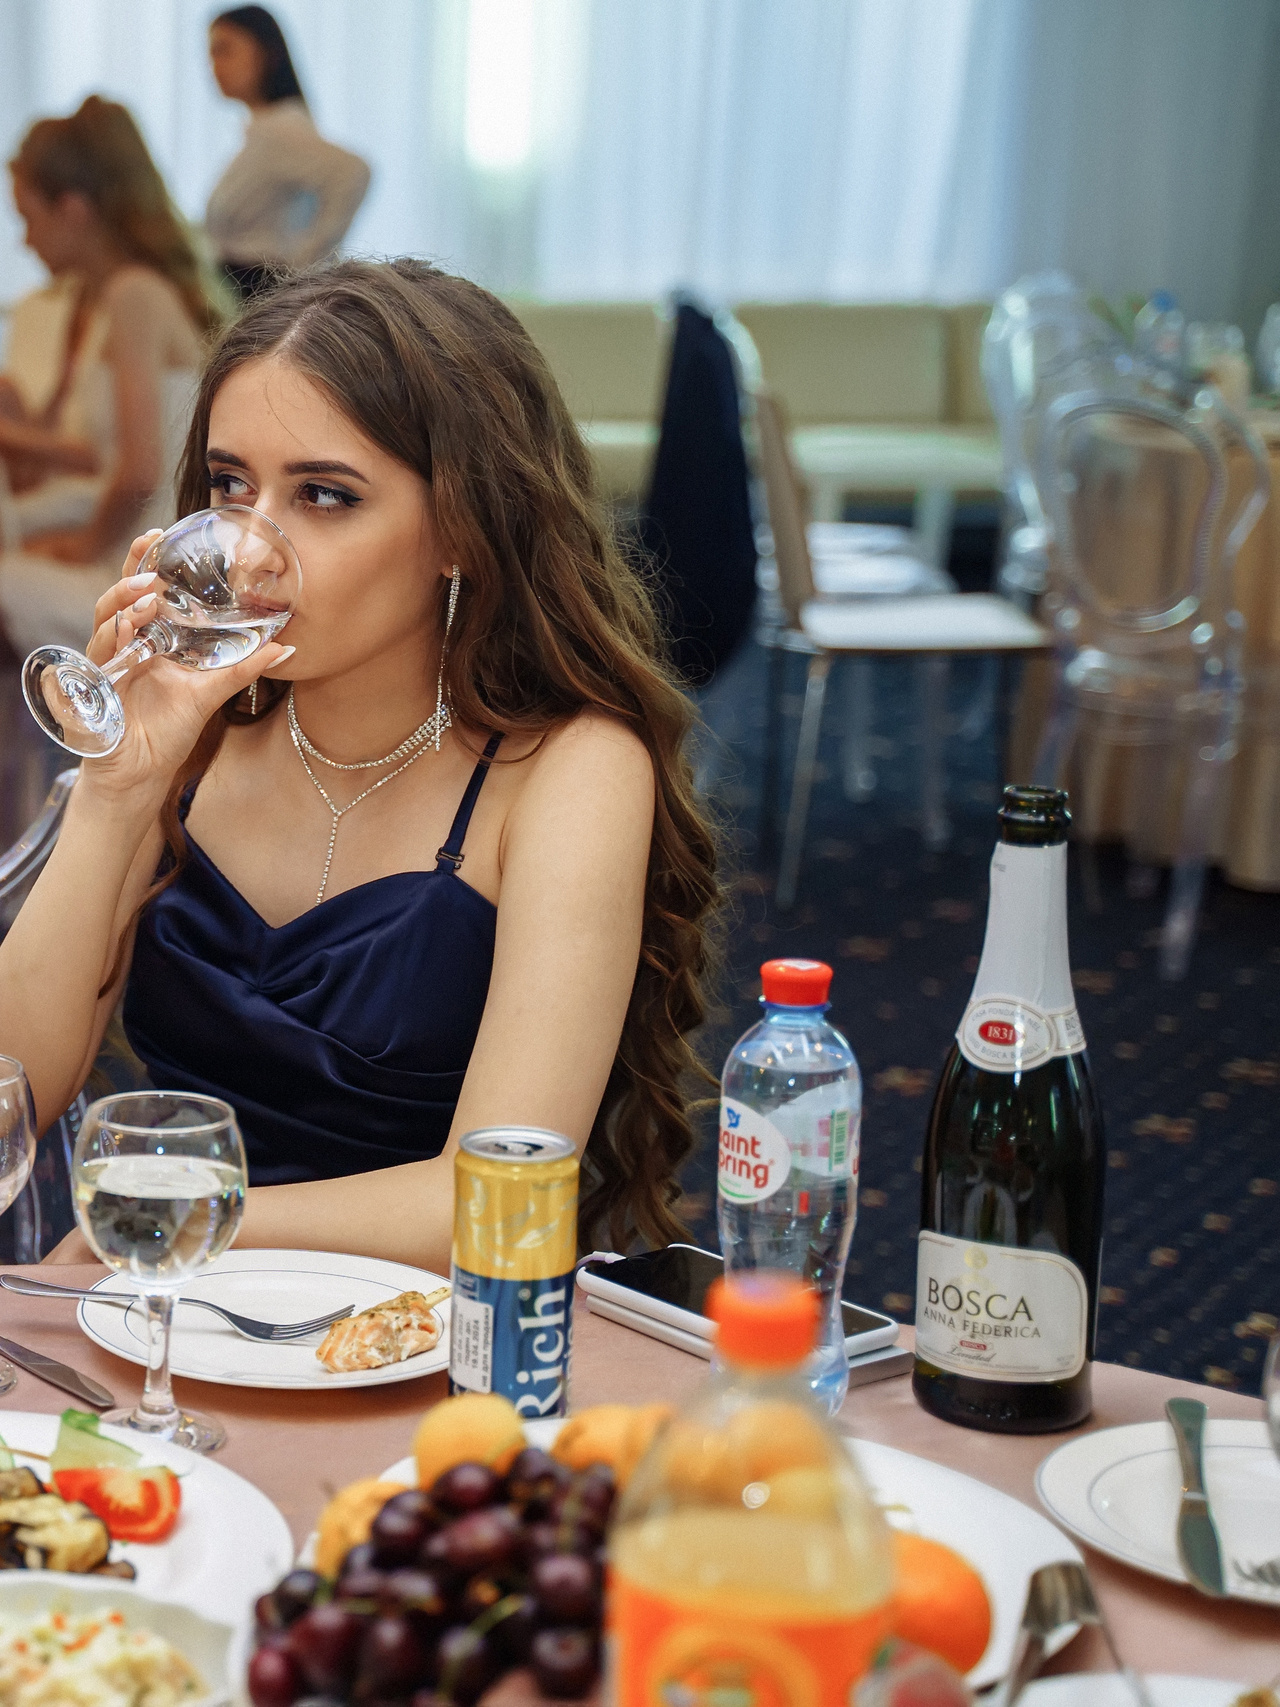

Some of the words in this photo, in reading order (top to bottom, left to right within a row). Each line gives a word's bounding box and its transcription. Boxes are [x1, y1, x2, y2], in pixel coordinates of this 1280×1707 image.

[987, 1025, 1014, 1041] 1831
[719, 1127, 761, 1159] aint
[719, 1149, 769, 1189] pring
[928, 1276, 1034, 1321] BOSCA
[923, 1307, 956, 1328] ANNA
[963, 1319, 1041, 1339] FEDERICA
[515, 1287, 566, 1417] Rich
